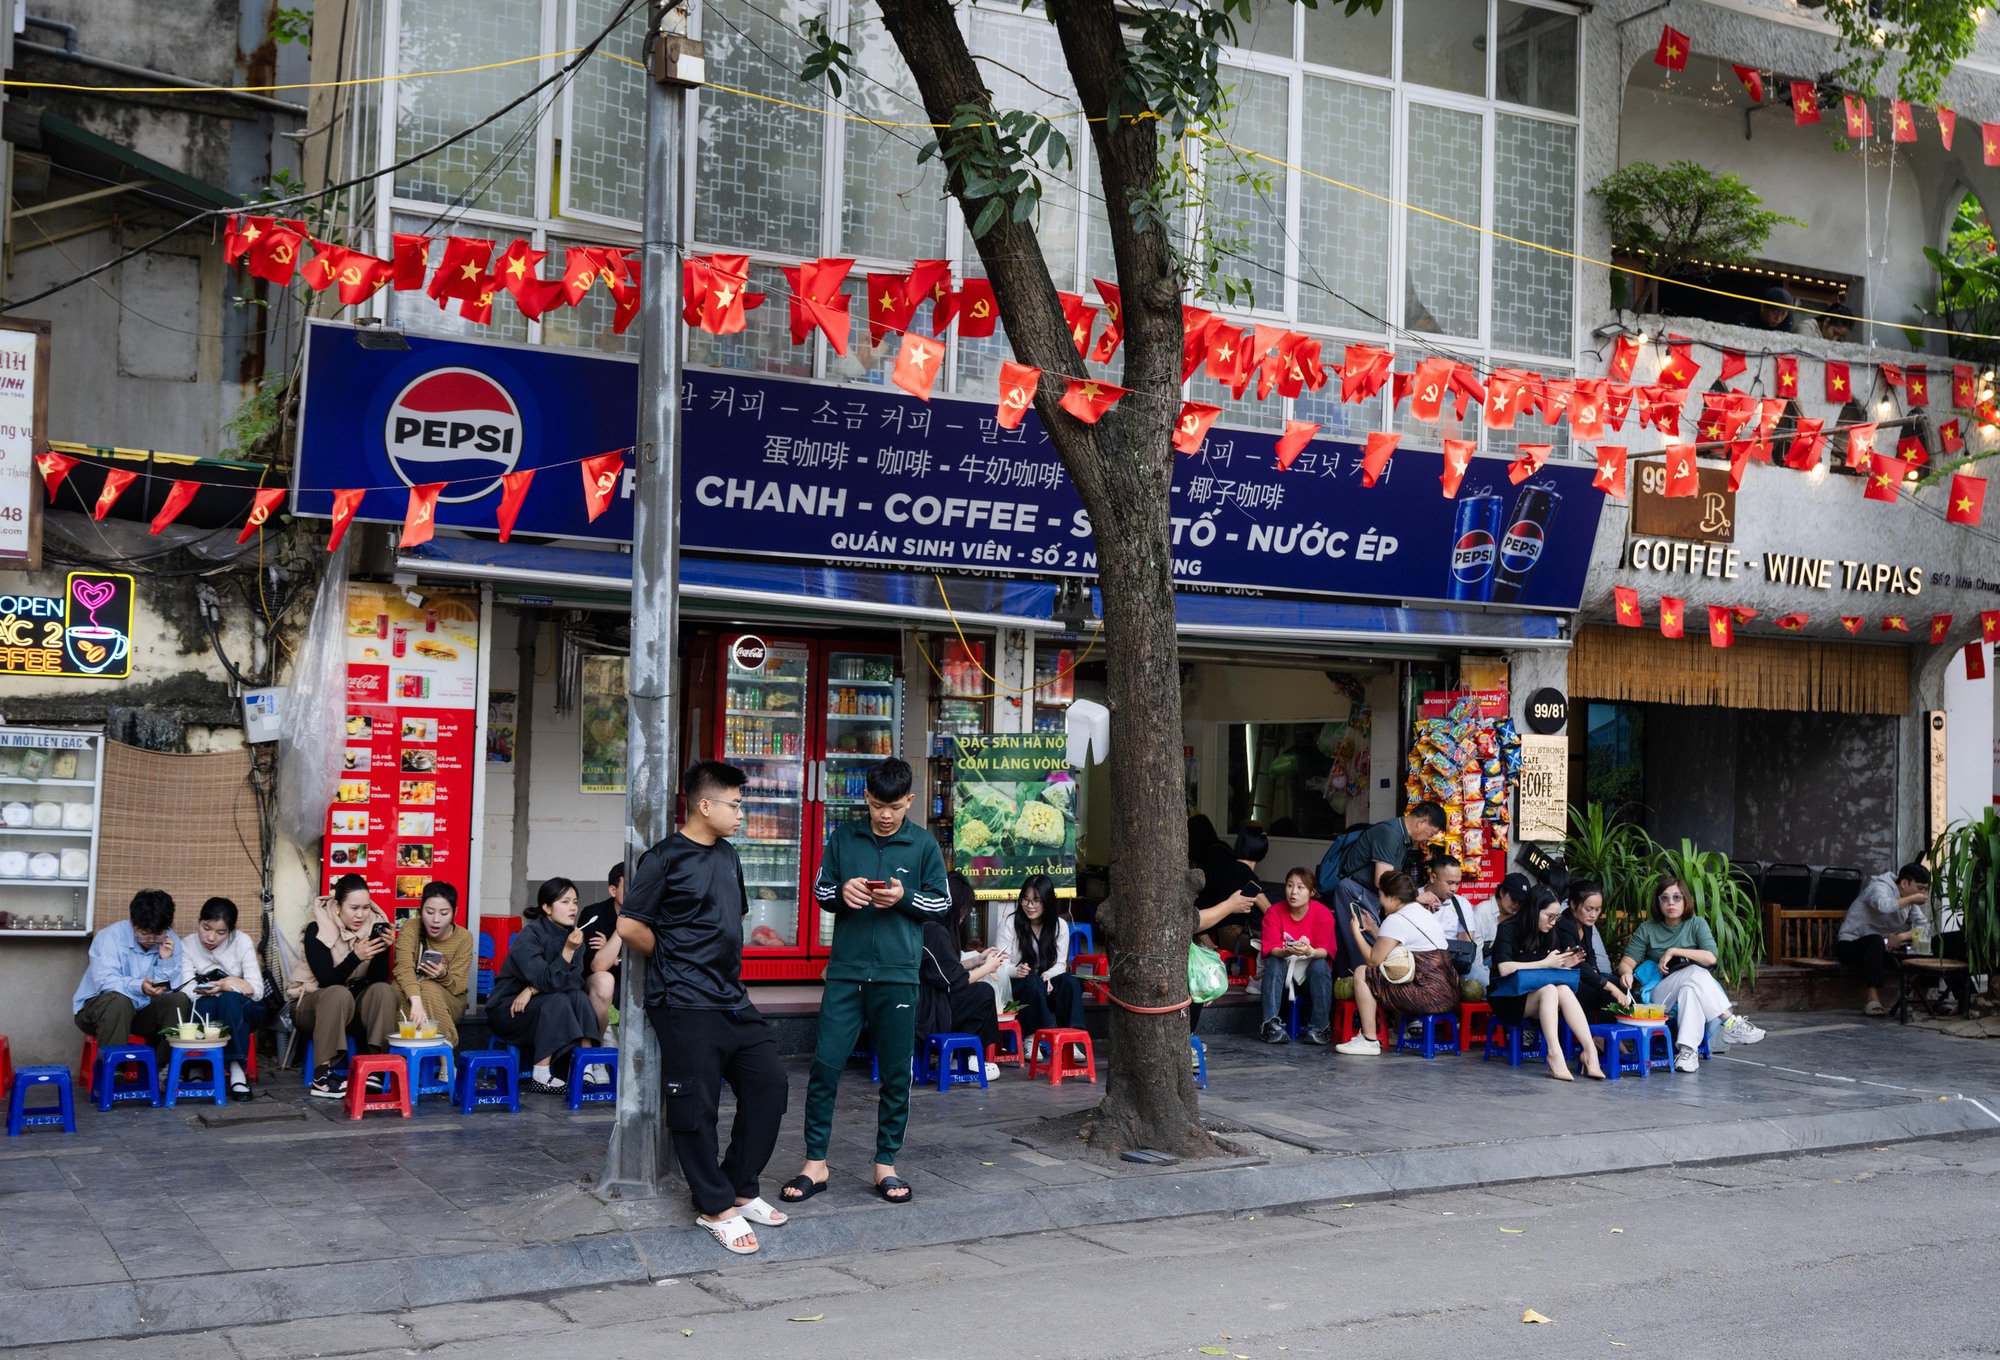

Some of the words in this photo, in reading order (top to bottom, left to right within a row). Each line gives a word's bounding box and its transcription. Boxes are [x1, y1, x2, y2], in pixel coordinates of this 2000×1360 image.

[709, 386, 765, 421] 커피
[811, 400, 869, 431] 소금
[880, 404, 932, 438] 커피
[394, 416, 514, 454] PEPSI
[763, 434, 850, 471] 蛋咖啡
[877, 446, 933, 479] 咖啡
[958, 453, 1065, 491] 牛奶咖啡
[1187, 475, 1285, 510] 椰子咖啡
[695, 475, 848, 518] CHANH
[884, 492, 1039, 533] COFFEE
[1170, 508, 1217, 547] TỐ
[1247, 521, 1349, 558] NƯỚC
[1355, 527, 1399, 562] ÉP
[830, 532, 897, 553] QUÁN
[902, 538, 954, 557] SINH
[961, 540, 1012, 561] VIÊN
[1030, 543, 1062, 566] SỐ
[1064, 551, 1077, 567] 2
[1504, 537, 1539, 557] PEPSI
[1455, 550, 1492, 564] PEPSI
[1632, 540, 1740, 579] COFFEE
[1766, 552, 1835, 589] WINE
[1842, 560, 1923, 596] TAPAS
[0, 596, 64, 618] OPEN
[42, 621, 64, 648] 2
[736, 646, 764, 659] Coca-Cola
[1534, 703, 1565, 719] 99/81
[38, 734, 58, 747] LÊN
[62, 735, 83, 748] GÁC
[960, 735, 989, 751] ĐẶC
[992, 734, 1020, 749] SẢN
[1023, 735, 1042, 749] HÀ
[1538, 746, 1565, 755] STRONG
[958, 755, 989, 770] CỐM
[993, 756, 1030, 770] LÀNG
[1033, 756, 1071, 770] VÒNG
[1523, 756, 1538, 764] CAFE
[983, 865, 1014, 876] Tươi
[1025, 865, 1044, 875] Xôi
[1047, 864, 1073, 875] Cốm
